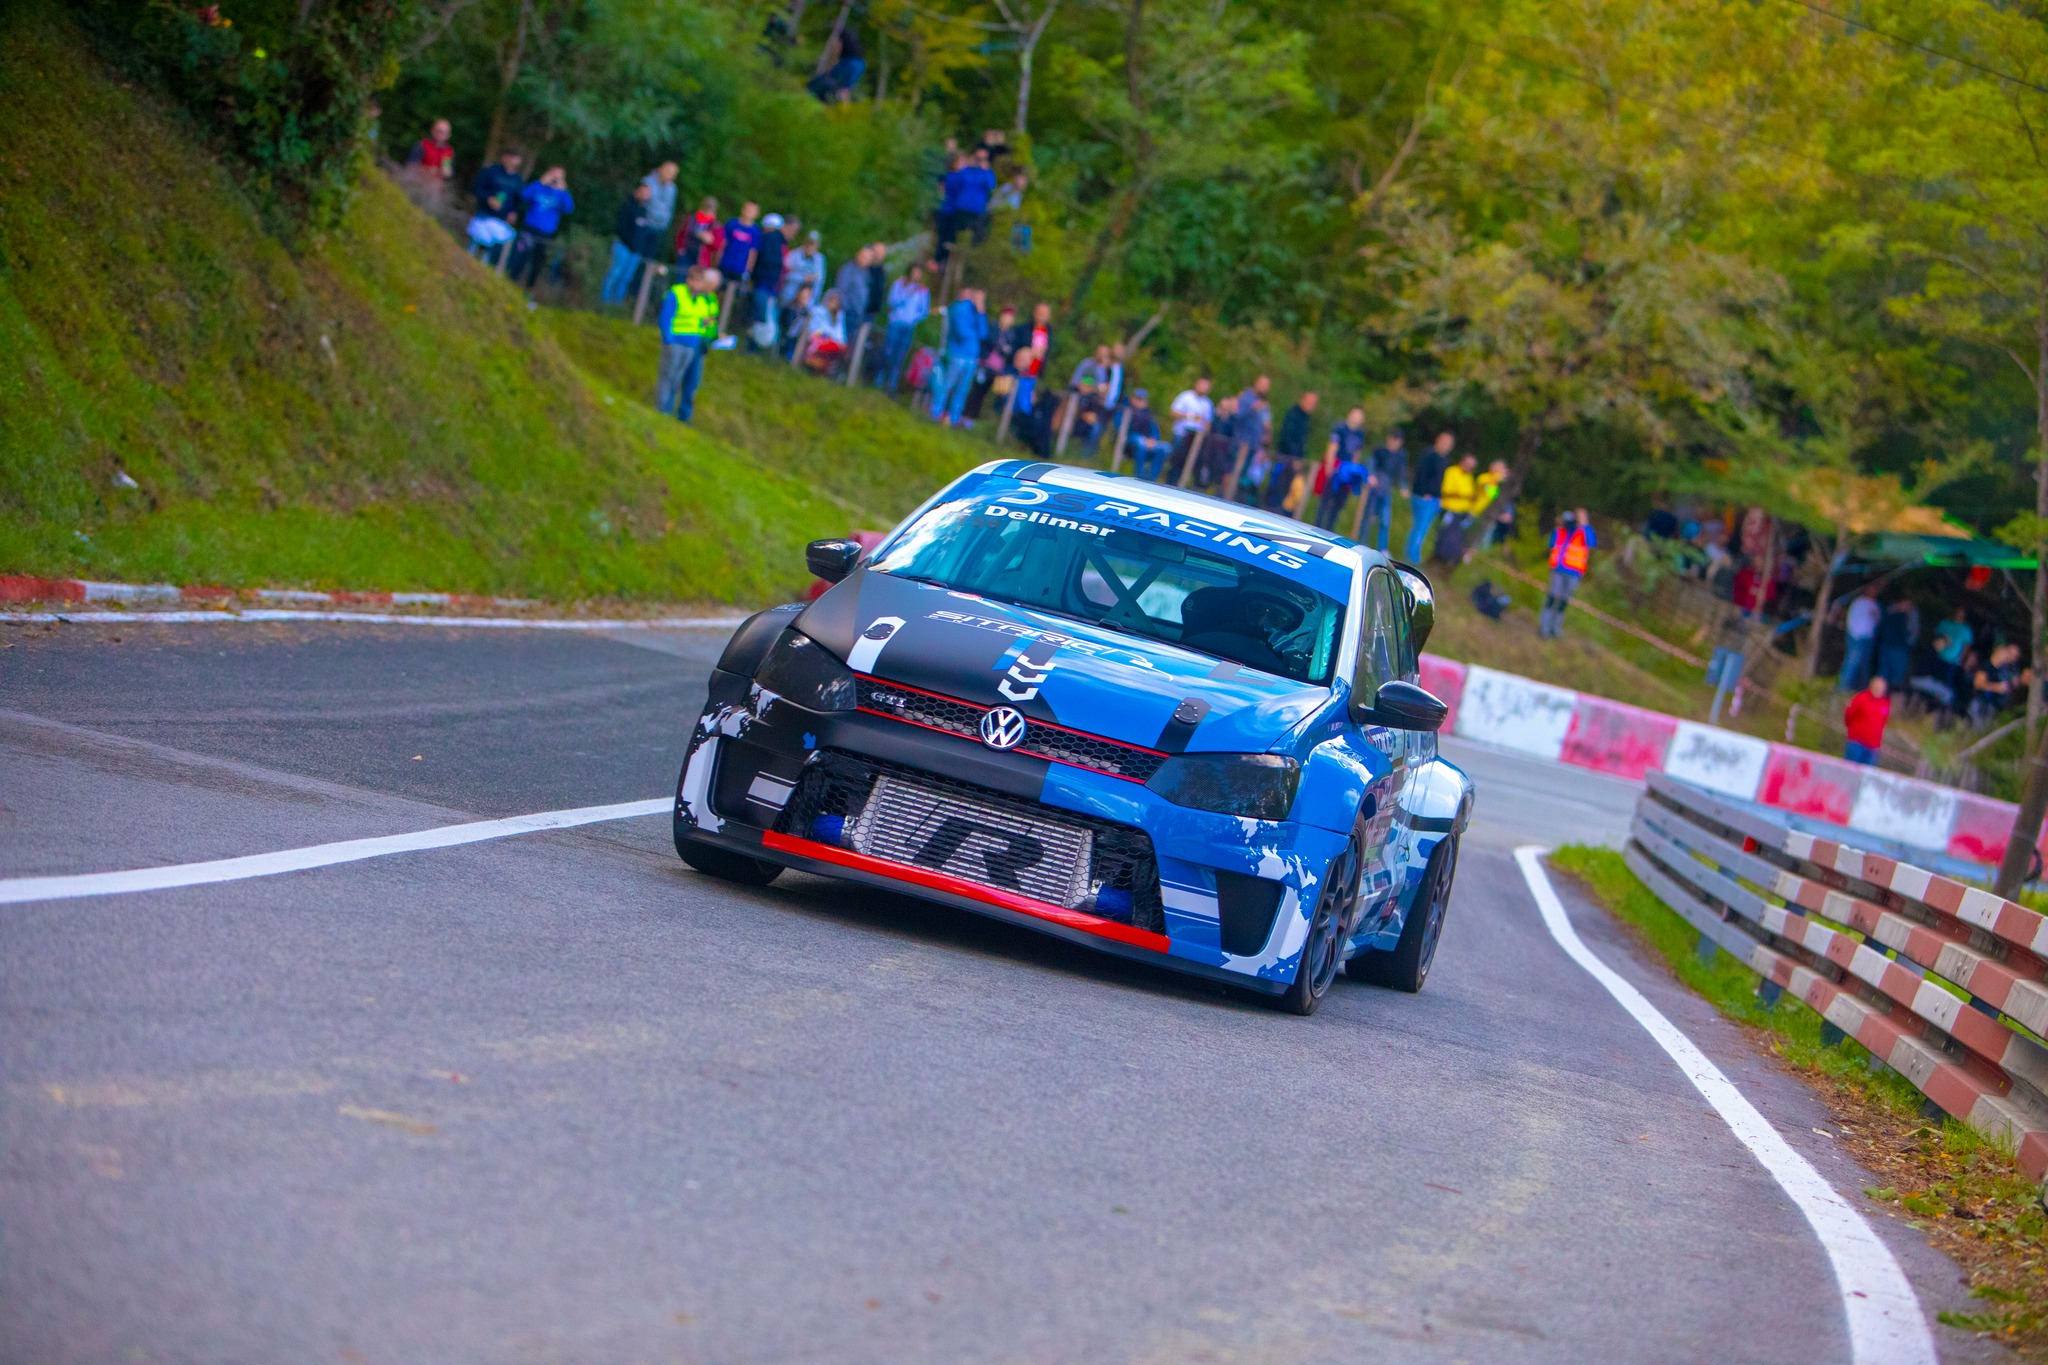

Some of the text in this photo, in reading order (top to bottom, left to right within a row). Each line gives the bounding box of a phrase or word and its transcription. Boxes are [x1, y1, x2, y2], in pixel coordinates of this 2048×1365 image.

[984, 505, 1116, 537] Delimar
[1087, 511, 1180, 537] PRELOG
[1094, 501, 1308, 570] RACING
[871, 691, 907, 708] GTI
